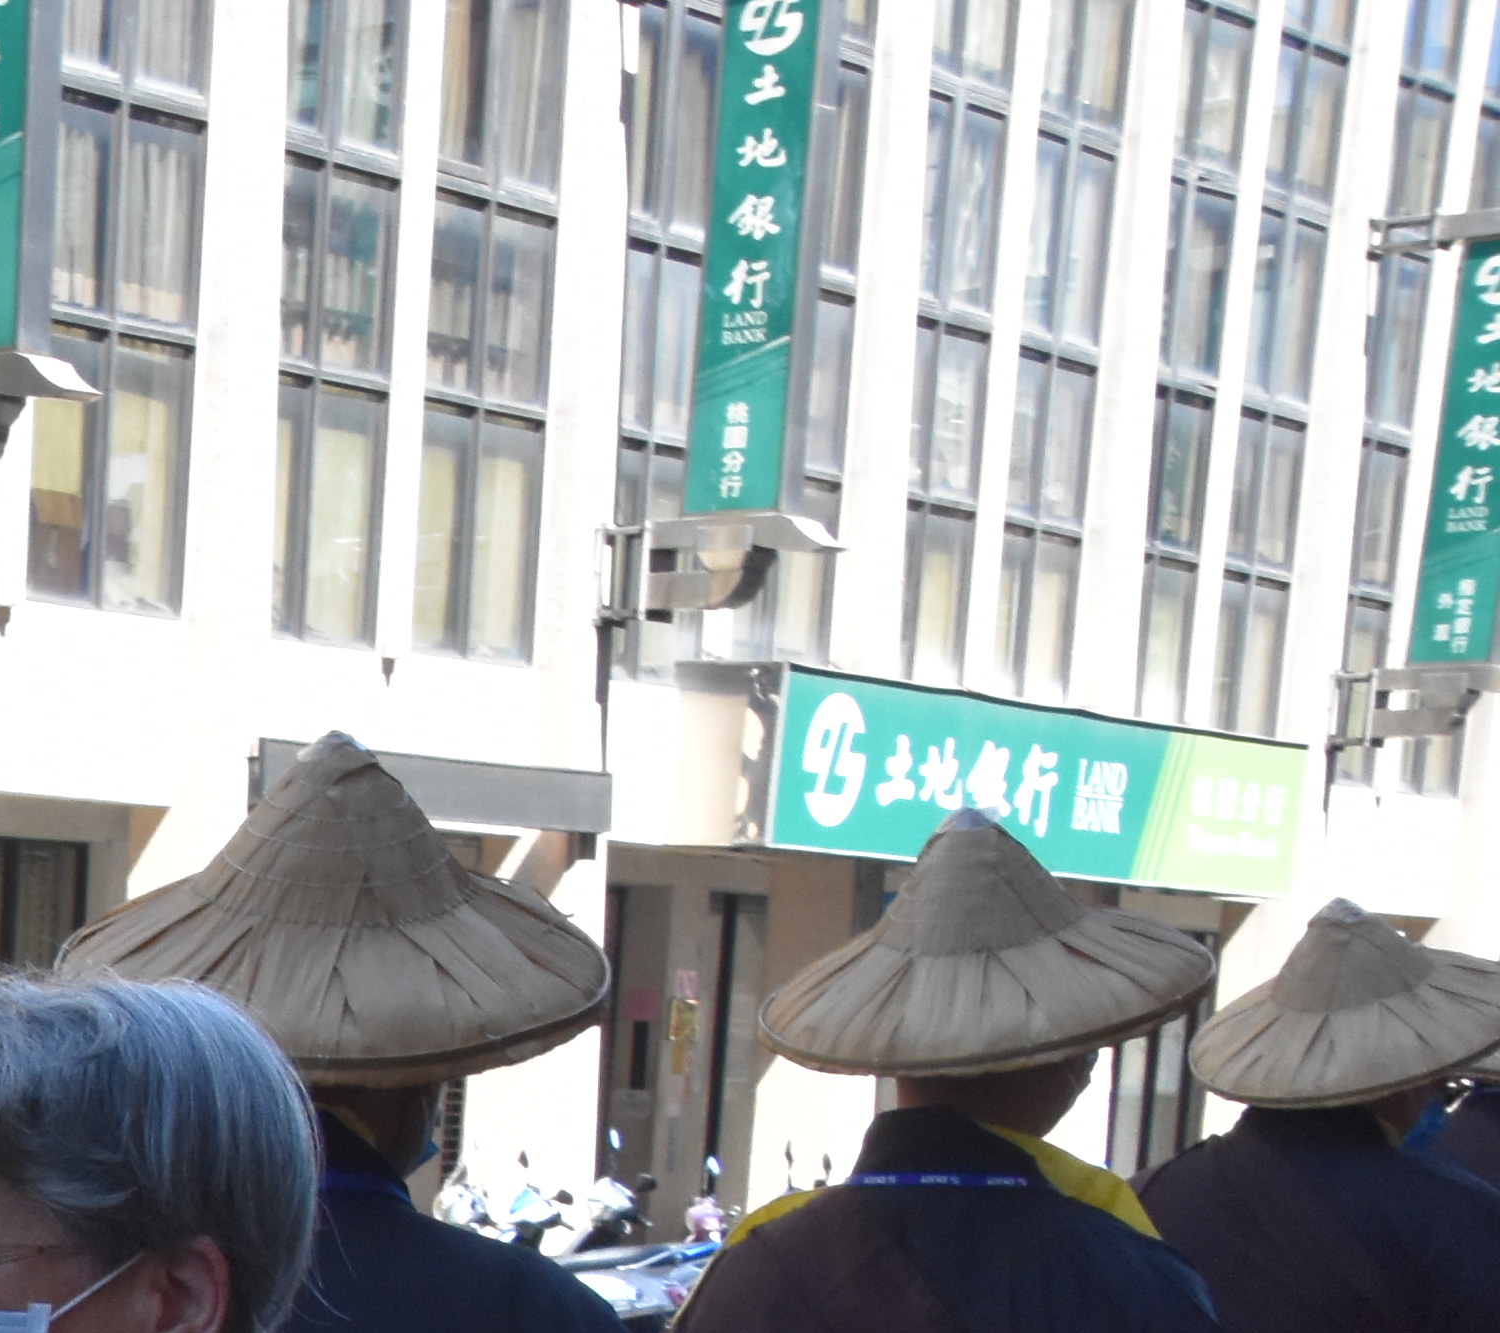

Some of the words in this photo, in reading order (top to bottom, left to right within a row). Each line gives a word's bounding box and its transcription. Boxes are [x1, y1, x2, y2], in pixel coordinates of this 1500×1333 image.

[722, 65, 787, 308] 土地銀行
[721, 328, 767, 346] BANK
[723, 310, 768, 328] LAND
[875, 734, 1058, 838] 土地銀行
[1077, 758, 1128, 796] LAND
[1071, 797, 1124, 834] BANK
